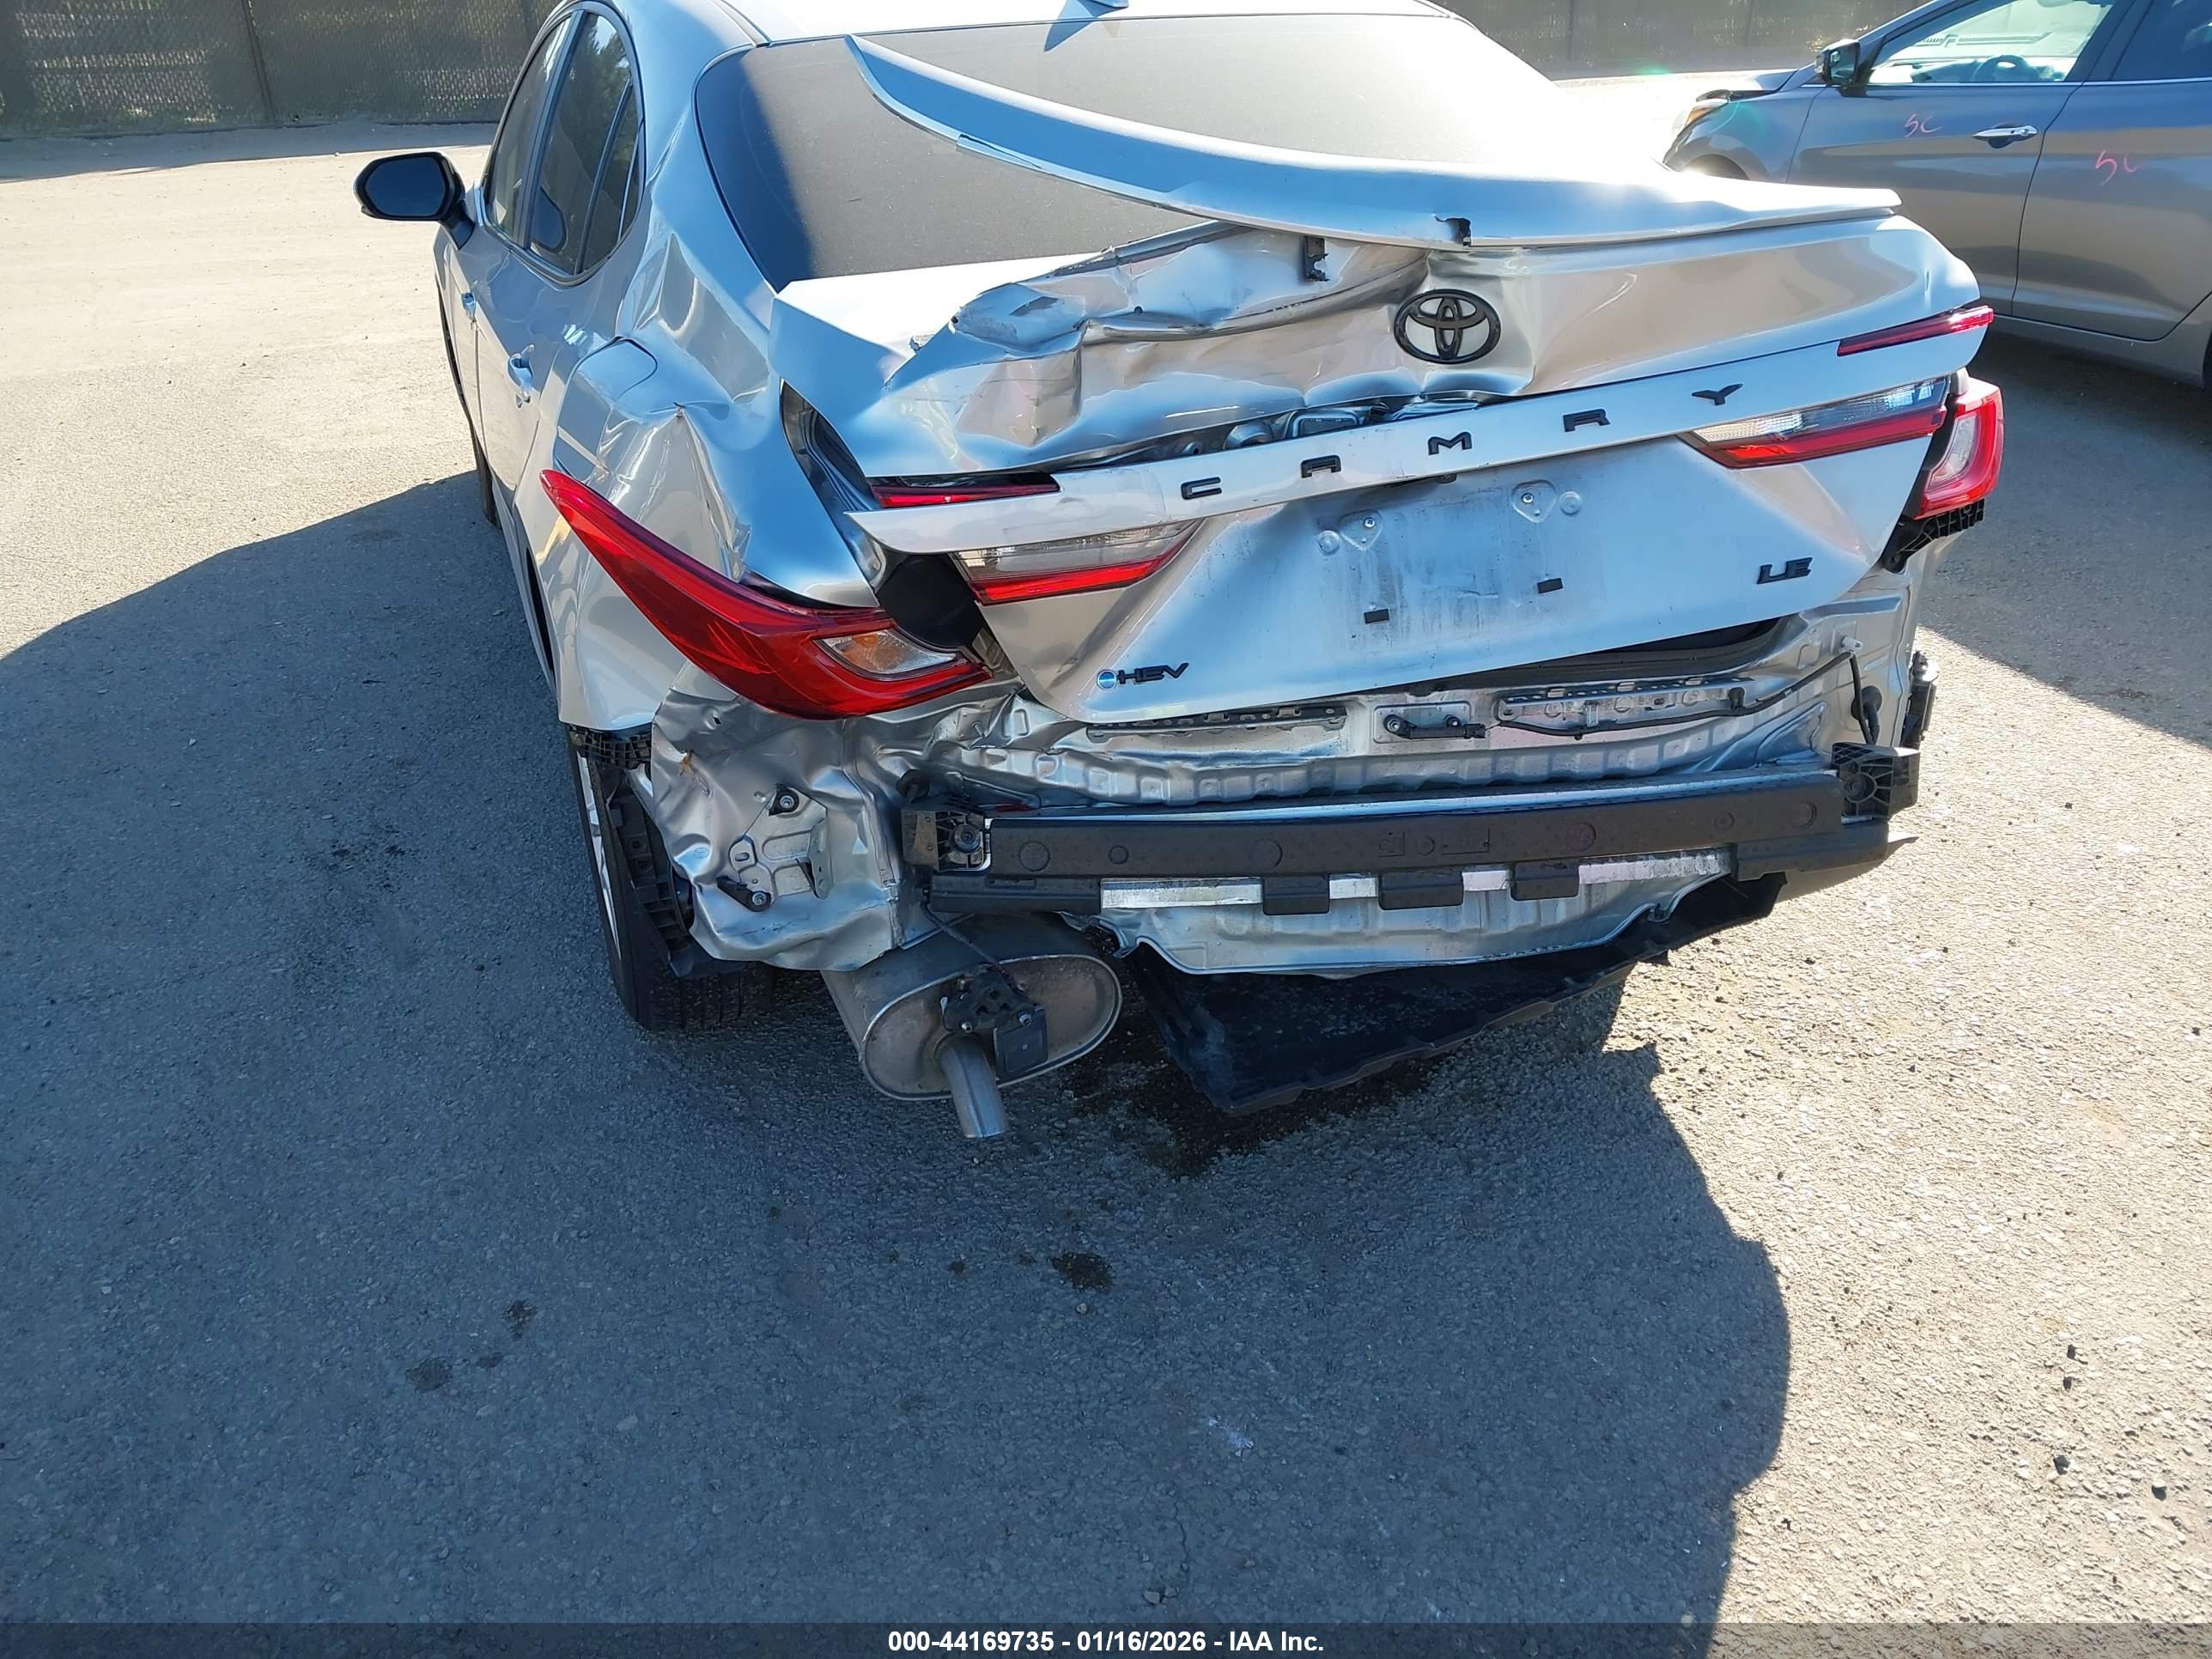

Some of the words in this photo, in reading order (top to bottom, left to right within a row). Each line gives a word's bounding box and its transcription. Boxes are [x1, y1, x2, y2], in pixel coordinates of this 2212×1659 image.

[1180, 382, 1743, 501] CAMRY
[1756, 556, 1814, 585] LE
[1116, 662, 1189, 685] HEV
